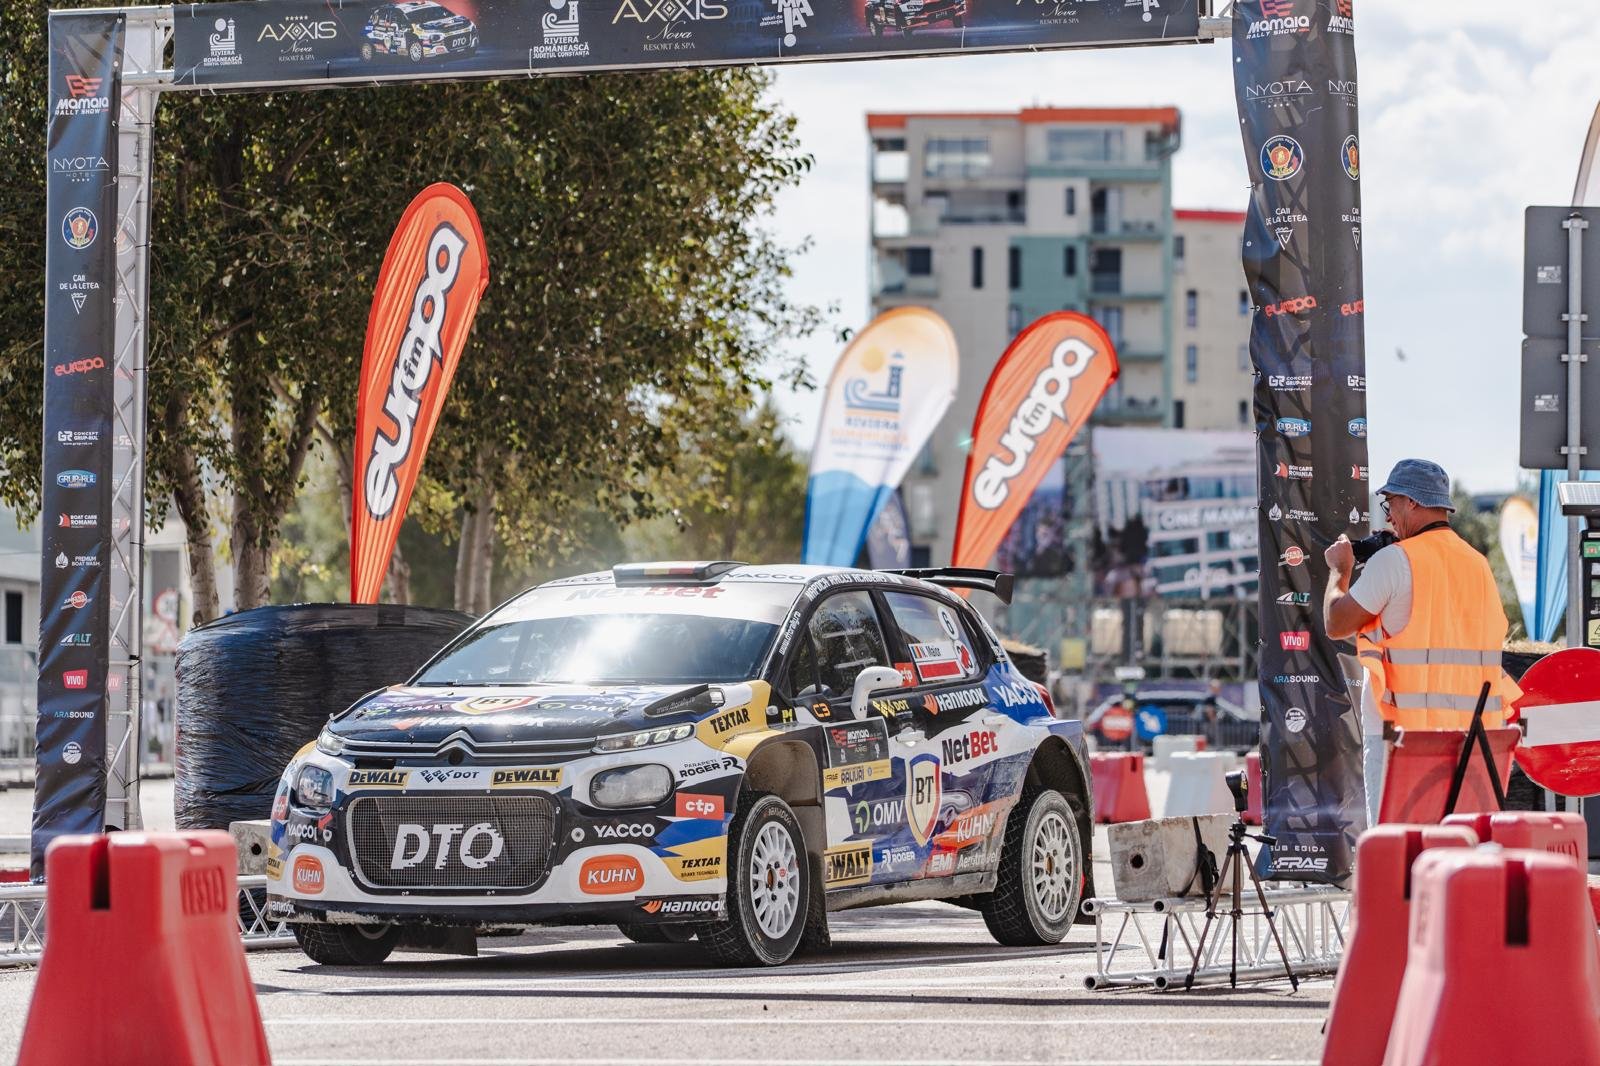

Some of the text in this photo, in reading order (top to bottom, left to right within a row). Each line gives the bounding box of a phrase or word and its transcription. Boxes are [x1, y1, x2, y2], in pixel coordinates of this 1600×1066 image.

[257, 21, 338, 43] AXXIS
[646, 21, 696, 41] Nova
[1246, 31, 1272, 40] RALLY
[1273, 27, 1298, 36] SHOW
[544, 37, 579, 45] RIVIERA
[643, 43, 673, 52] RESORT
[682, 41, 696, 50] SPA
[1246, 80, 1313, 98] NYOTA
[1328, 80, 1357, 95] NYOT
[82, 107, 101, 115] SHOW
[54, 157, 110, 171] NYOTA
[60, 281, 99, 291] DE LA LETEA
[403, 335, 424, 377] fm
[1021, 401, 1047, 428] fm
[1273, 674, 1320, 684] ARASOUND
[893, 699, 910, 712] DOT
[709, 707, 751, 735] TEXTAR
[942, 730, 999, 767] NetBet
[679, 763, 721, 778] ROGER
[684, 759, 717, 769] PARAPETI
[453, 770, 481, 780] DOT
[915, 775, 935, 806] BT
[685, 799, 716, 816] ctp
[872, 799, 906, 826] OMV
[592, 823, 656, 838] YACCO
[957, 811, 995, 844] KUHN
[389, 821, 505, 871] DTO
[681, 857, 721, 869] TEXTAR
[824, 851, 870, 880] EWALT
[890, 851, 916, 864] ROGER
[296, 867, 321, 884] KUHN
[585, 870, 642, 887] KUHN
